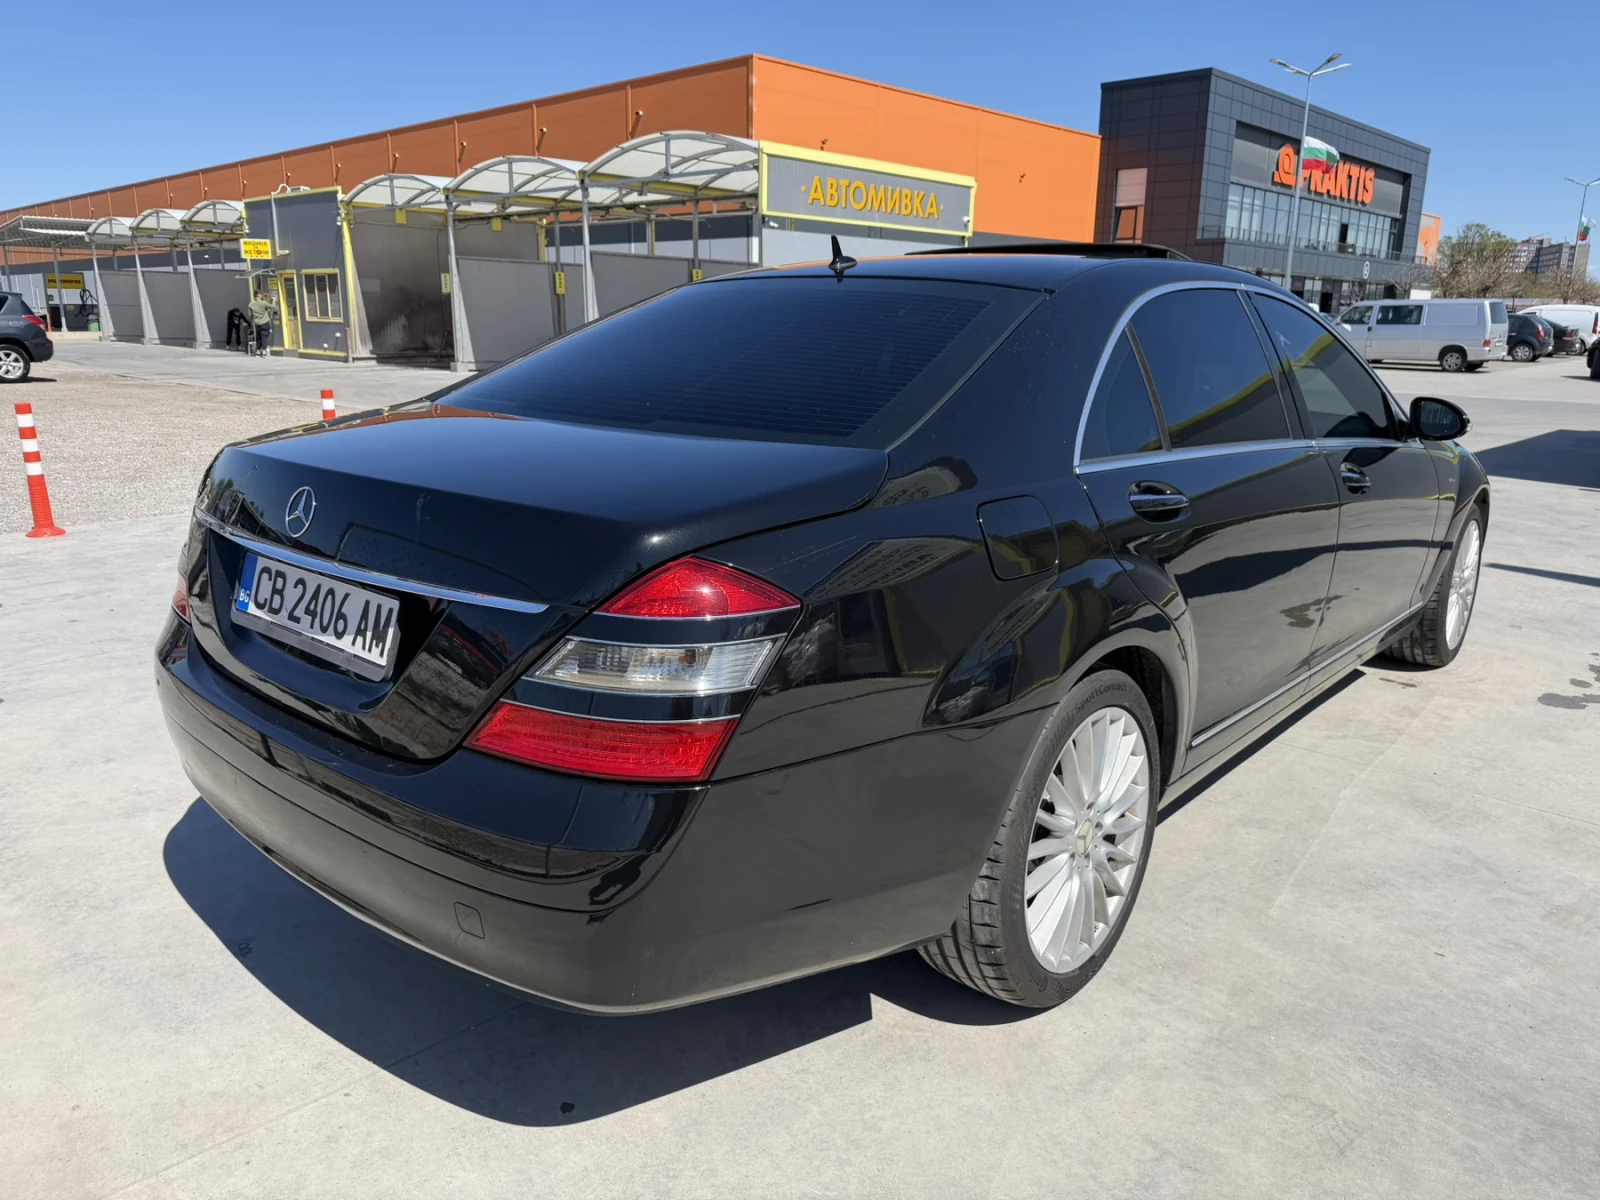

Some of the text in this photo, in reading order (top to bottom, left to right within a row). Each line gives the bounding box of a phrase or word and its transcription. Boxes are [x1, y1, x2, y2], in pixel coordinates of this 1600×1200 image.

[808, 175, 939, 220] АВТОМИВКА
[239, 589, 250, 603] BG
[254, 566, 394, 658] CB 2406 AM
[1074, 682, 1127, 714] SportContact
